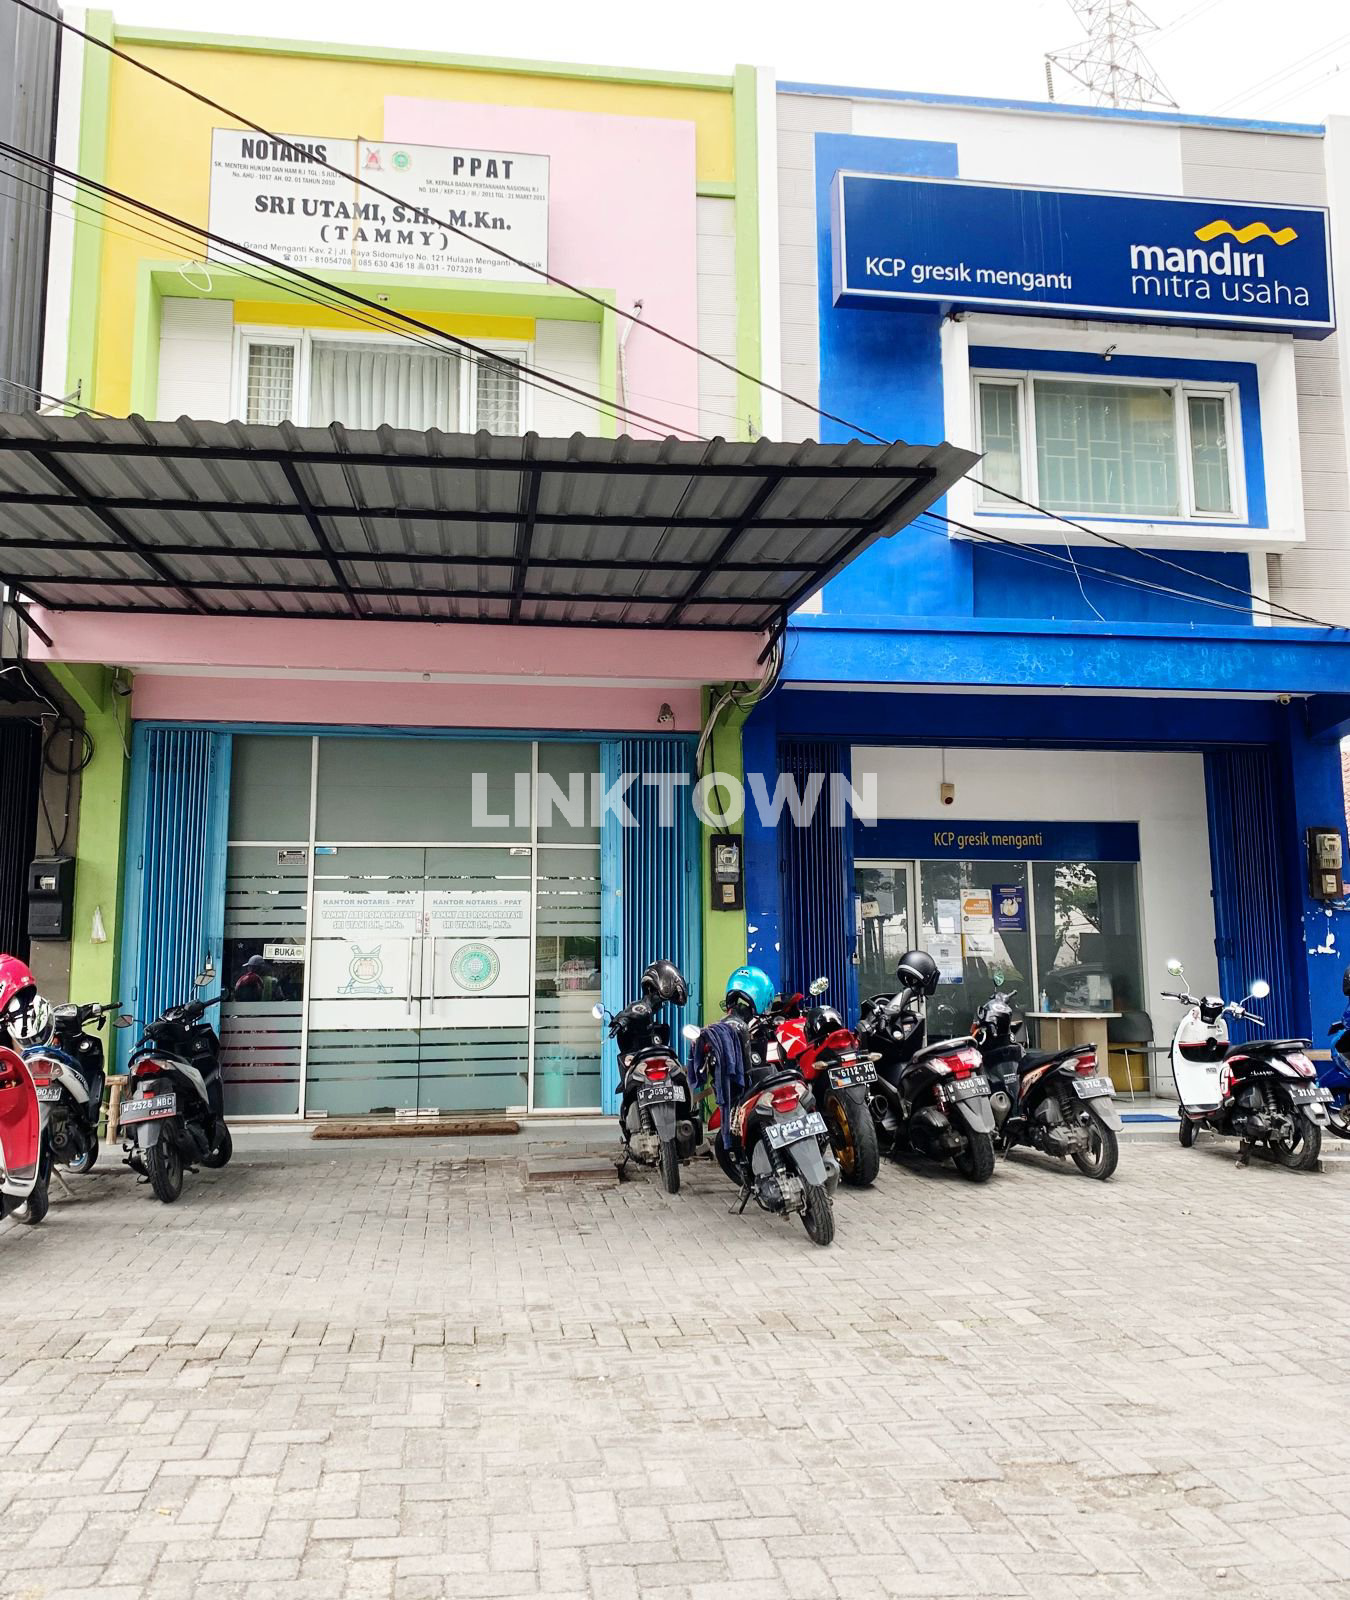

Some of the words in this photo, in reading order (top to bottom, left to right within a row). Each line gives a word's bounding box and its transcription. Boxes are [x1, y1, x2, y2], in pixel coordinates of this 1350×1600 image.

[241, 138, 327, 165] NOTARIS
[225, 162, 248, 170] MENTERI
[453, 156, 513, 180] PPAT
[254, 195, 295, 215] SRI
[303, 199, 386, 224] UTAMI,
[450, 209, 512, 231] M.Kn.
[244, 242, 268, 251] Grand
[270, 243, 307, 256] Menganti
[309, 246, 325, 255] Kav.
[327, 247, 332, 255] 2
[351, 249, 370, 260] Raya
[372, 250, 413, 263] Sidomulyo
[414, 253, 428, 261] No.
[432, 254, 445, 262] 121
[447, 255, 474, 264] Hulaan
[476, 257, 511, 269] Menganti
[294, 255, 307, 263] 031
[315, 256, 352, 266] 81054708
[358, 259, 372, 267] 085
[373, 260, 385, 268] 630
[387, 260, 404, 269] 436
[426, 263, 439, 271] 031
[446, 264, 482, 274] 70732818
[865, 256, 906, 277] KCP
[1131, 272, 1211, 300] mitra
[1223, 278, 1310, 306] usaha
[933, 832, 955, 846] KCP
[957, 832, 990, 849] gresik
[992, 832, 1042, 849] menganti
[321, 911, 348, 919] TAMMY
[432, 911, 457, 919] TAMMY
[274, 948, 295, 956] BUKA
